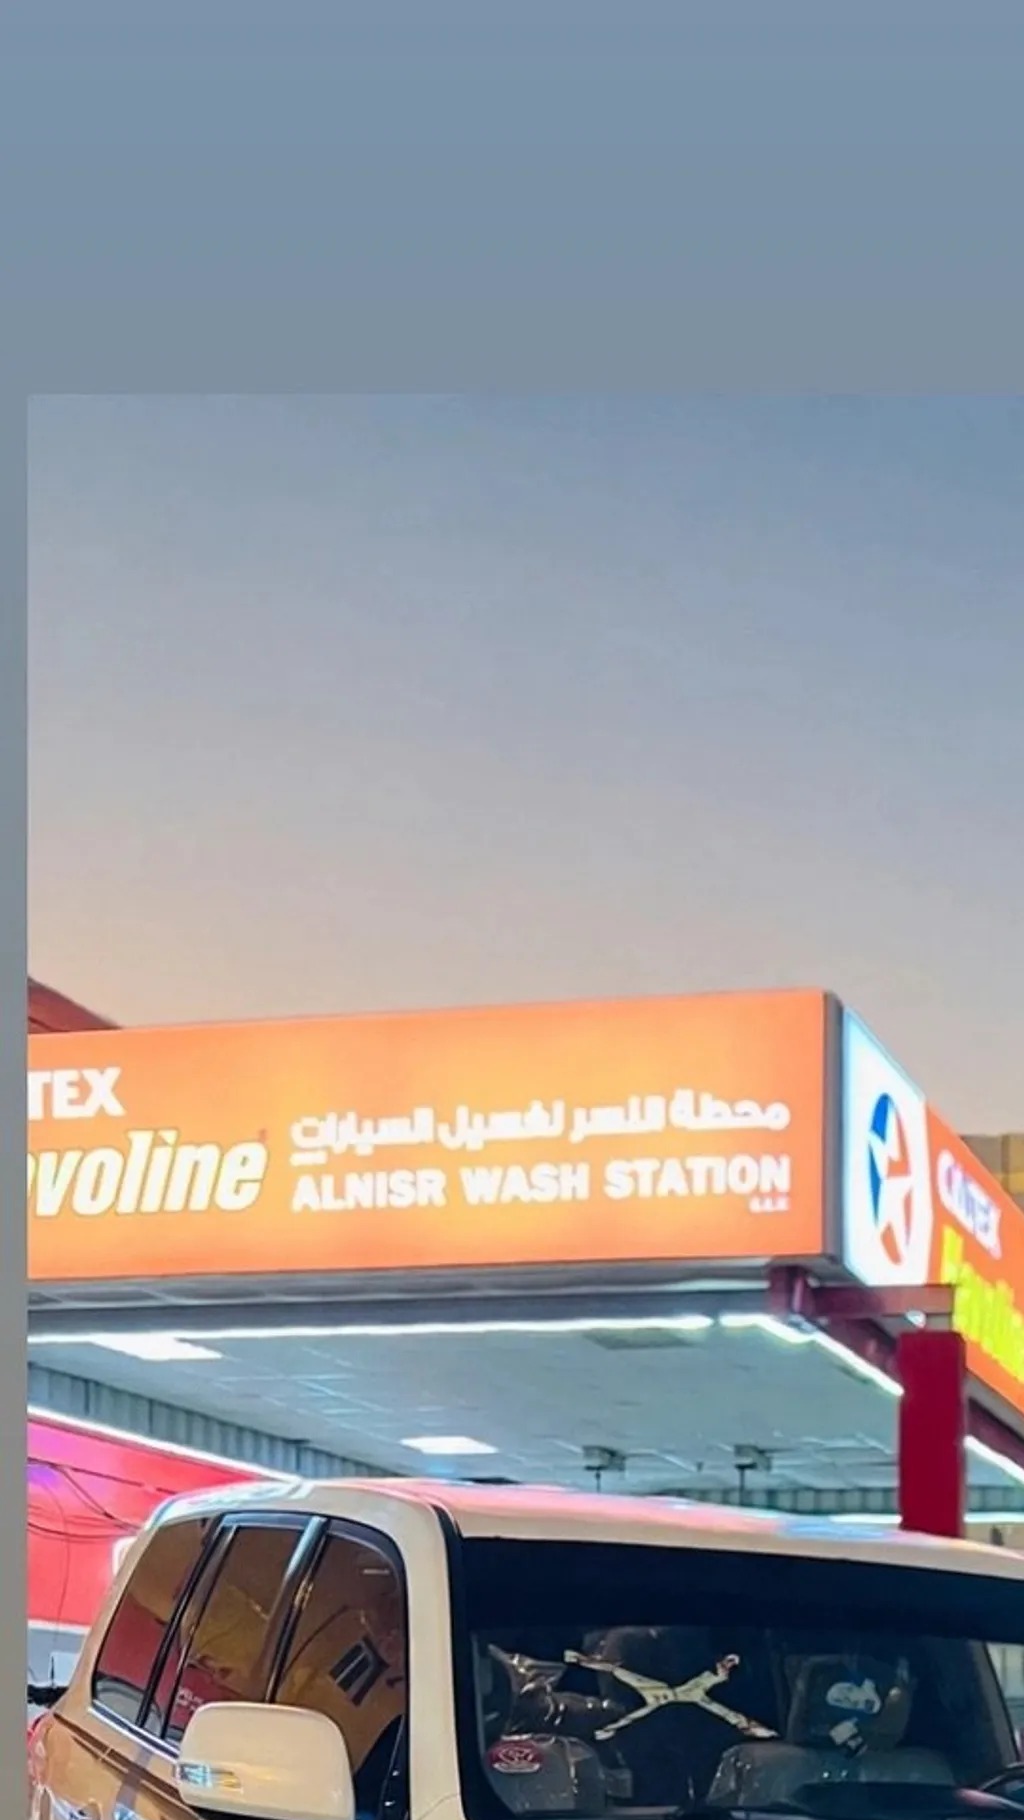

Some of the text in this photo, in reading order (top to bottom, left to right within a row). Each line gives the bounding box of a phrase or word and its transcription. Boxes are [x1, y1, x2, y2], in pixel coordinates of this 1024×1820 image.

[289, 1087, 791, 1156] محطة النسر لغسيل السيارات
[27, 1127, 269, 1217] voline
[290, 1153, 791, 1213] ALNISR WASH STATION
